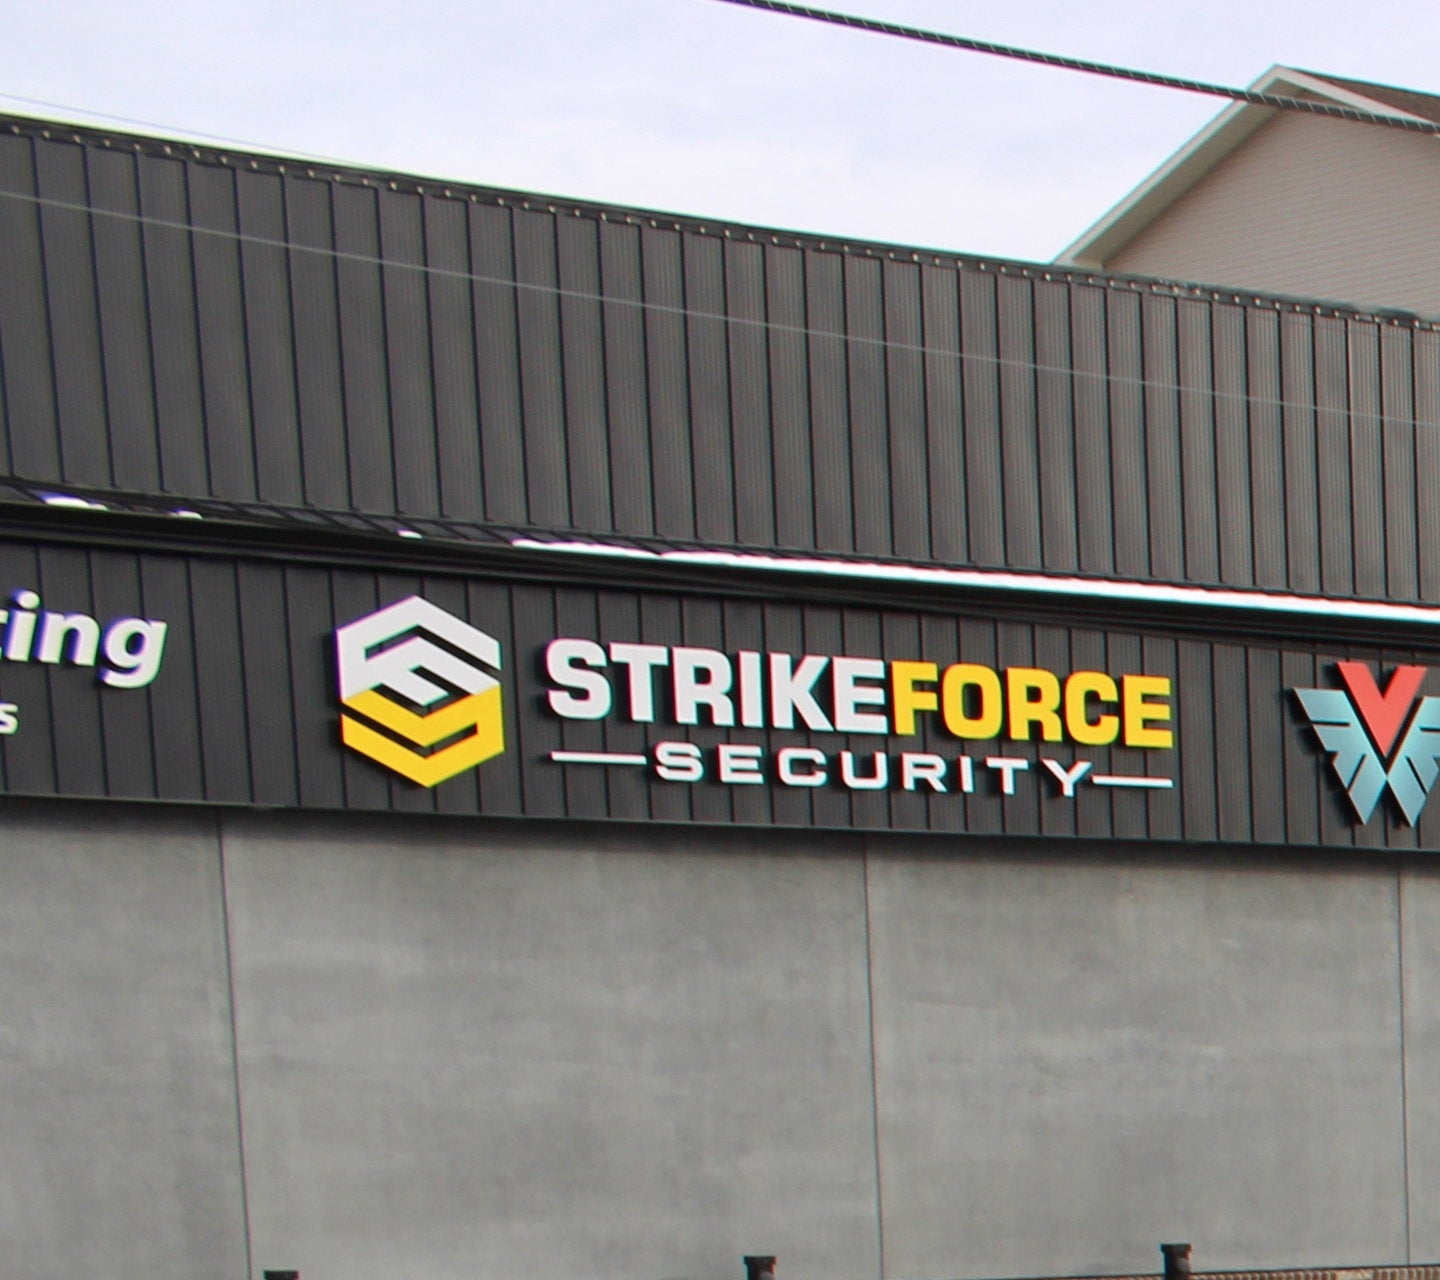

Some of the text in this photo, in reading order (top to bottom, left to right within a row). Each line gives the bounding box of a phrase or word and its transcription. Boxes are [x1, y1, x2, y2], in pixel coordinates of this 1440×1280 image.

[0, 588, 168, 689] ing
[546, 638, 1173, 748] STRIKEFORCE
[655, 740, 1091, 798] SECURITY
